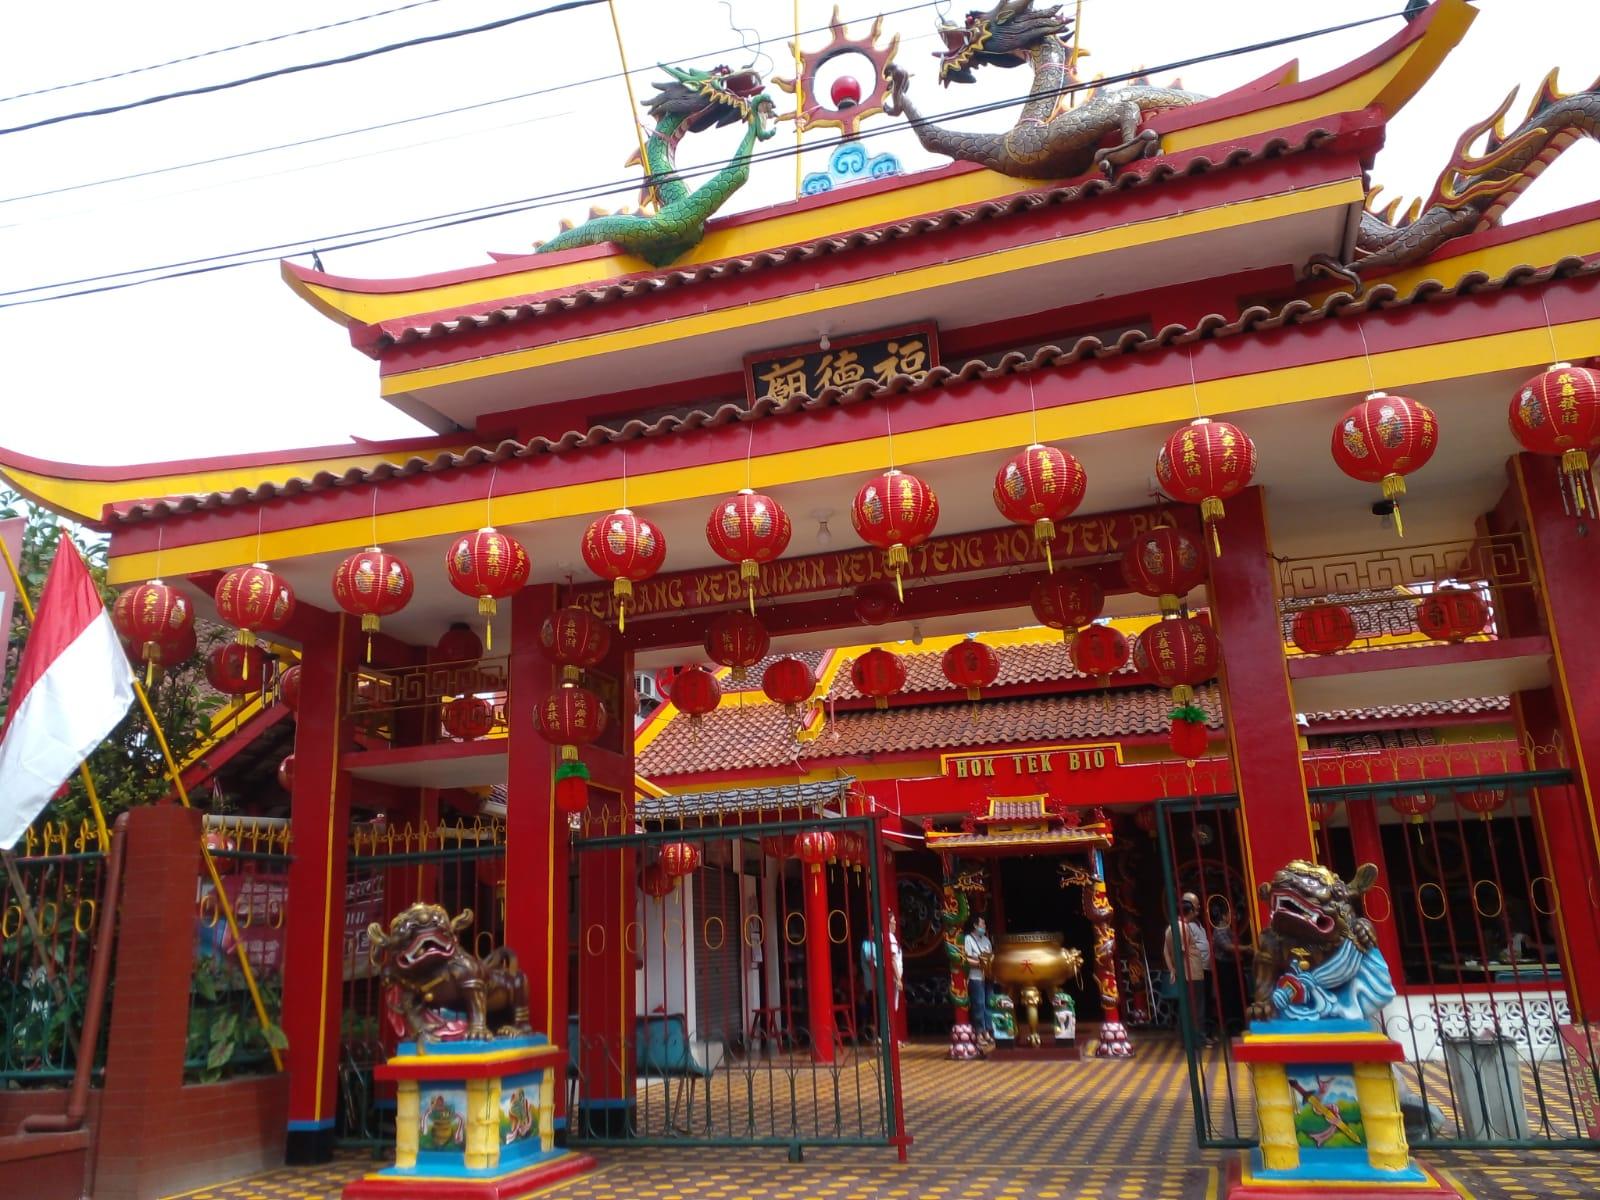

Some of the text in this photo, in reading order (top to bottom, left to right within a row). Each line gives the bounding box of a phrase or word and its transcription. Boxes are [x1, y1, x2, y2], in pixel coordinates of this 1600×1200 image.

[1060, 517, 1119, 554] TEK
[956, 751, 1105, 778] HOK TEK BIO
[1575, 1072, 1587, 1096] TEK
[1582, 1099, 1597, 1127] HOK
